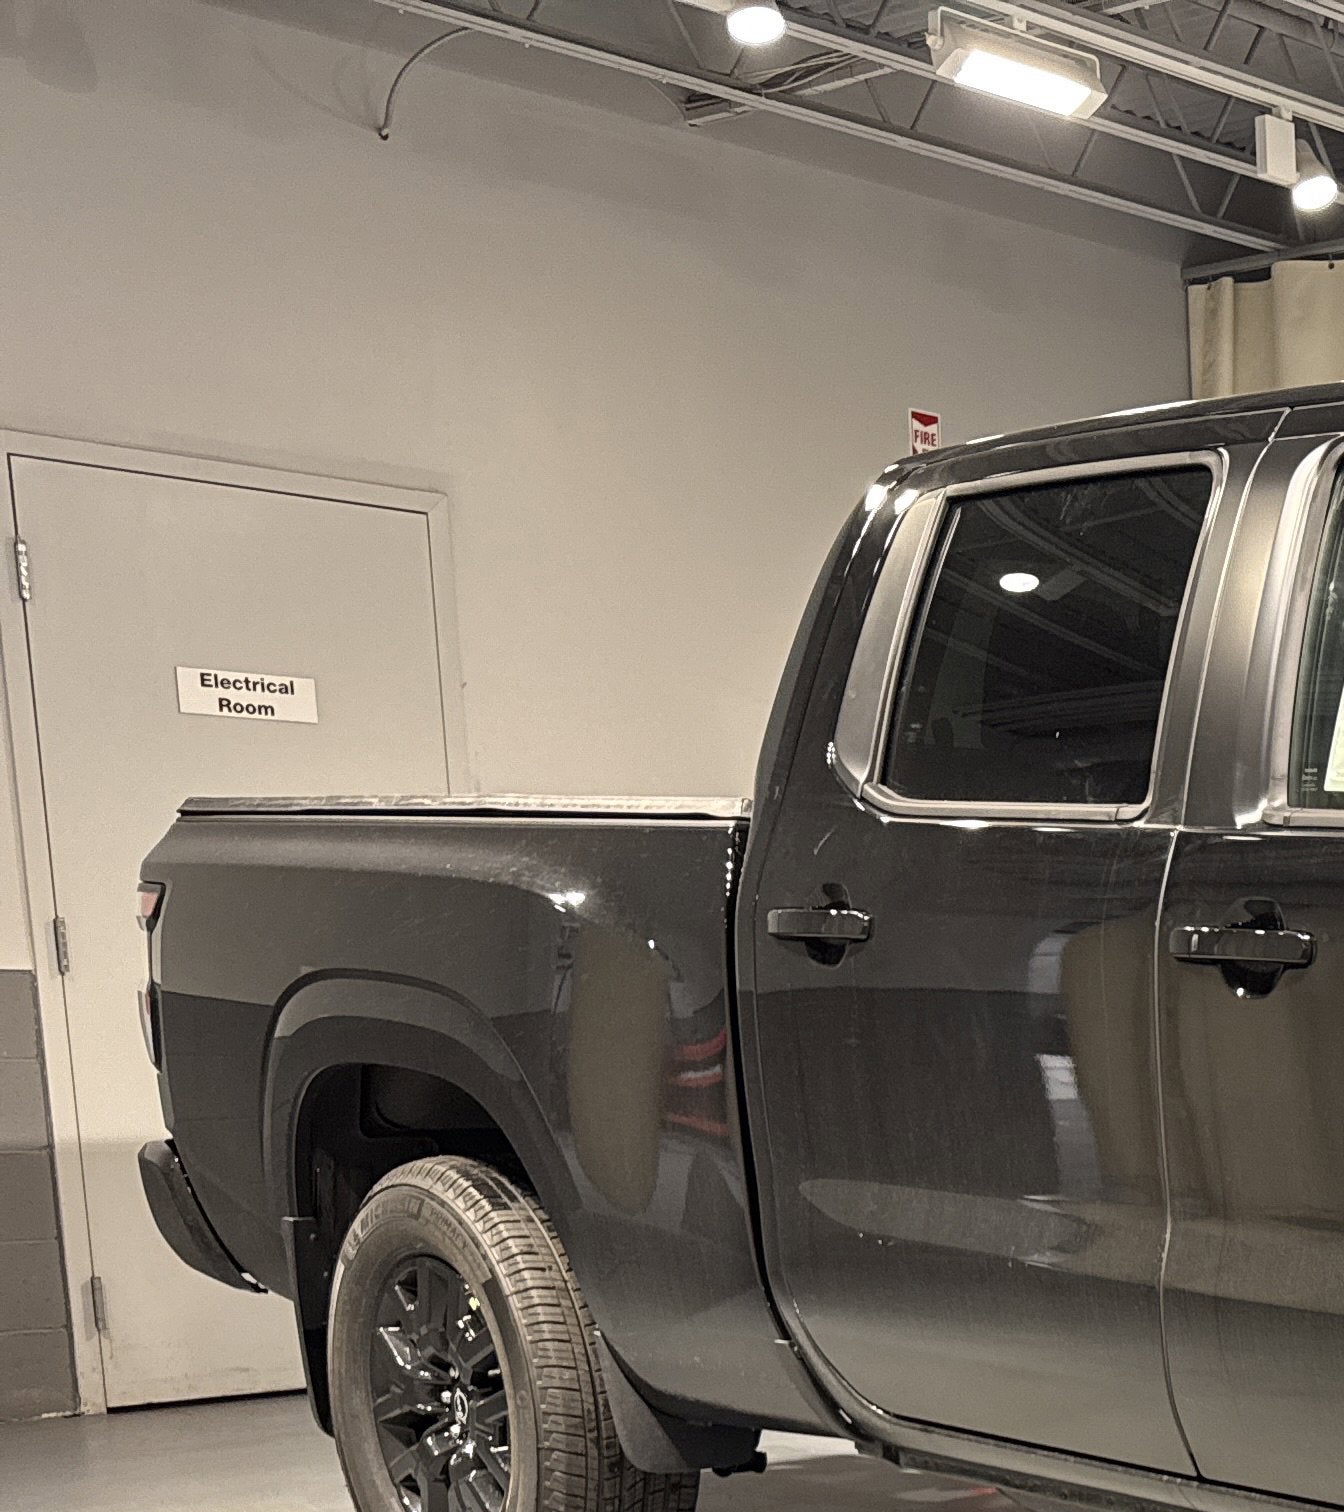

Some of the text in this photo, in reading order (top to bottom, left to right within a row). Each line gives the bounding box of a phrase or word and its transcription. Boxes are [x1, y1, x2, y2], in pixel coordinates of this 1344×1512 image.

[913, 429, 937, 447] FIRE
[199, 672, 295, 696] Electrical
[218, 697, 275, 717] Room
